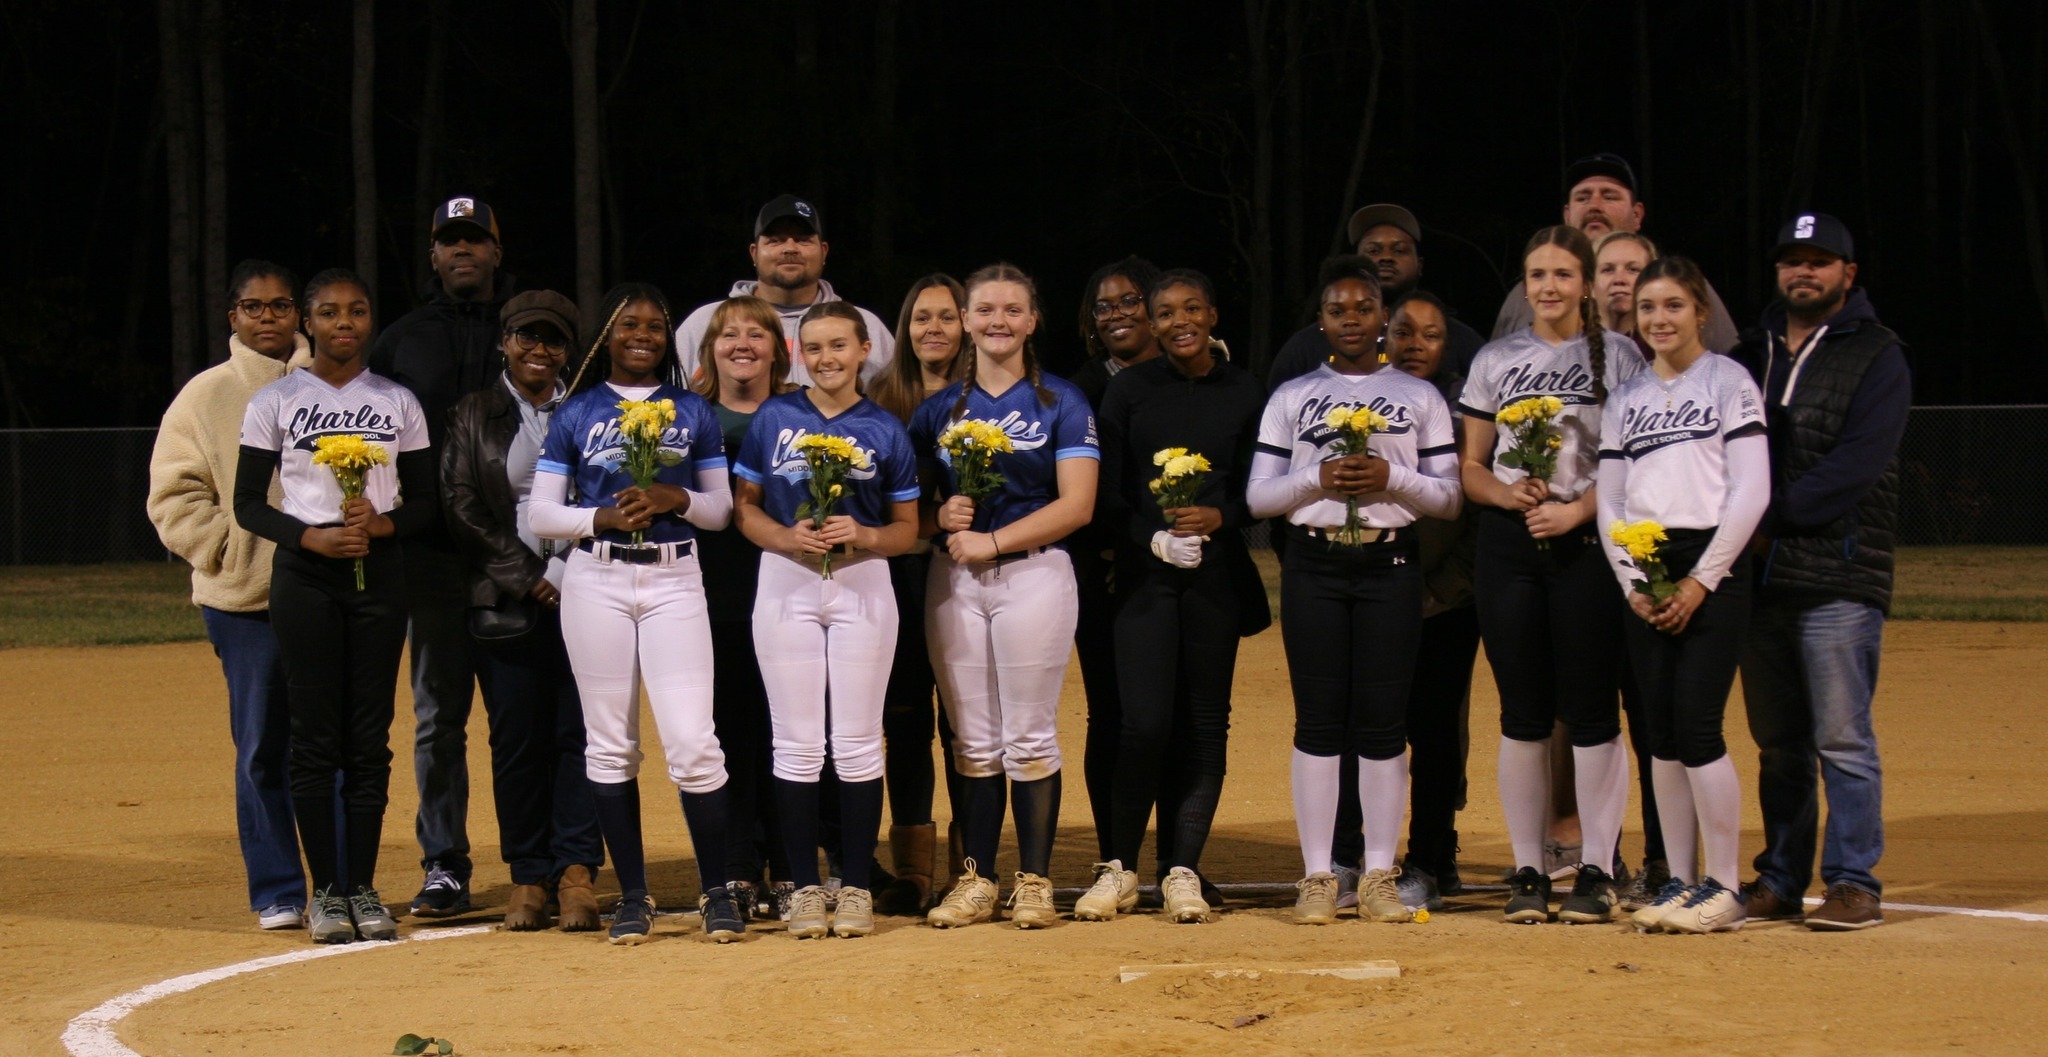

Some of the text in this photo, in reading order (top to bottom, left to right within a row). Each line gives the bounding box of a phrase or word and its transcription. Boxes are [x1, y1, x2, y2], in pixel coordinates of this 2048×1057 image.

[1794, 215, 1815, 239] S
[289, 403, 398, 442] Charles
[1620, 400, 1720, 443] Charles
[583, 418, 693, 459] Chaes
[1084, 436, 1099, 446] 202
[1630, 431, 1693, 452] MIDDLE SCHOOL
